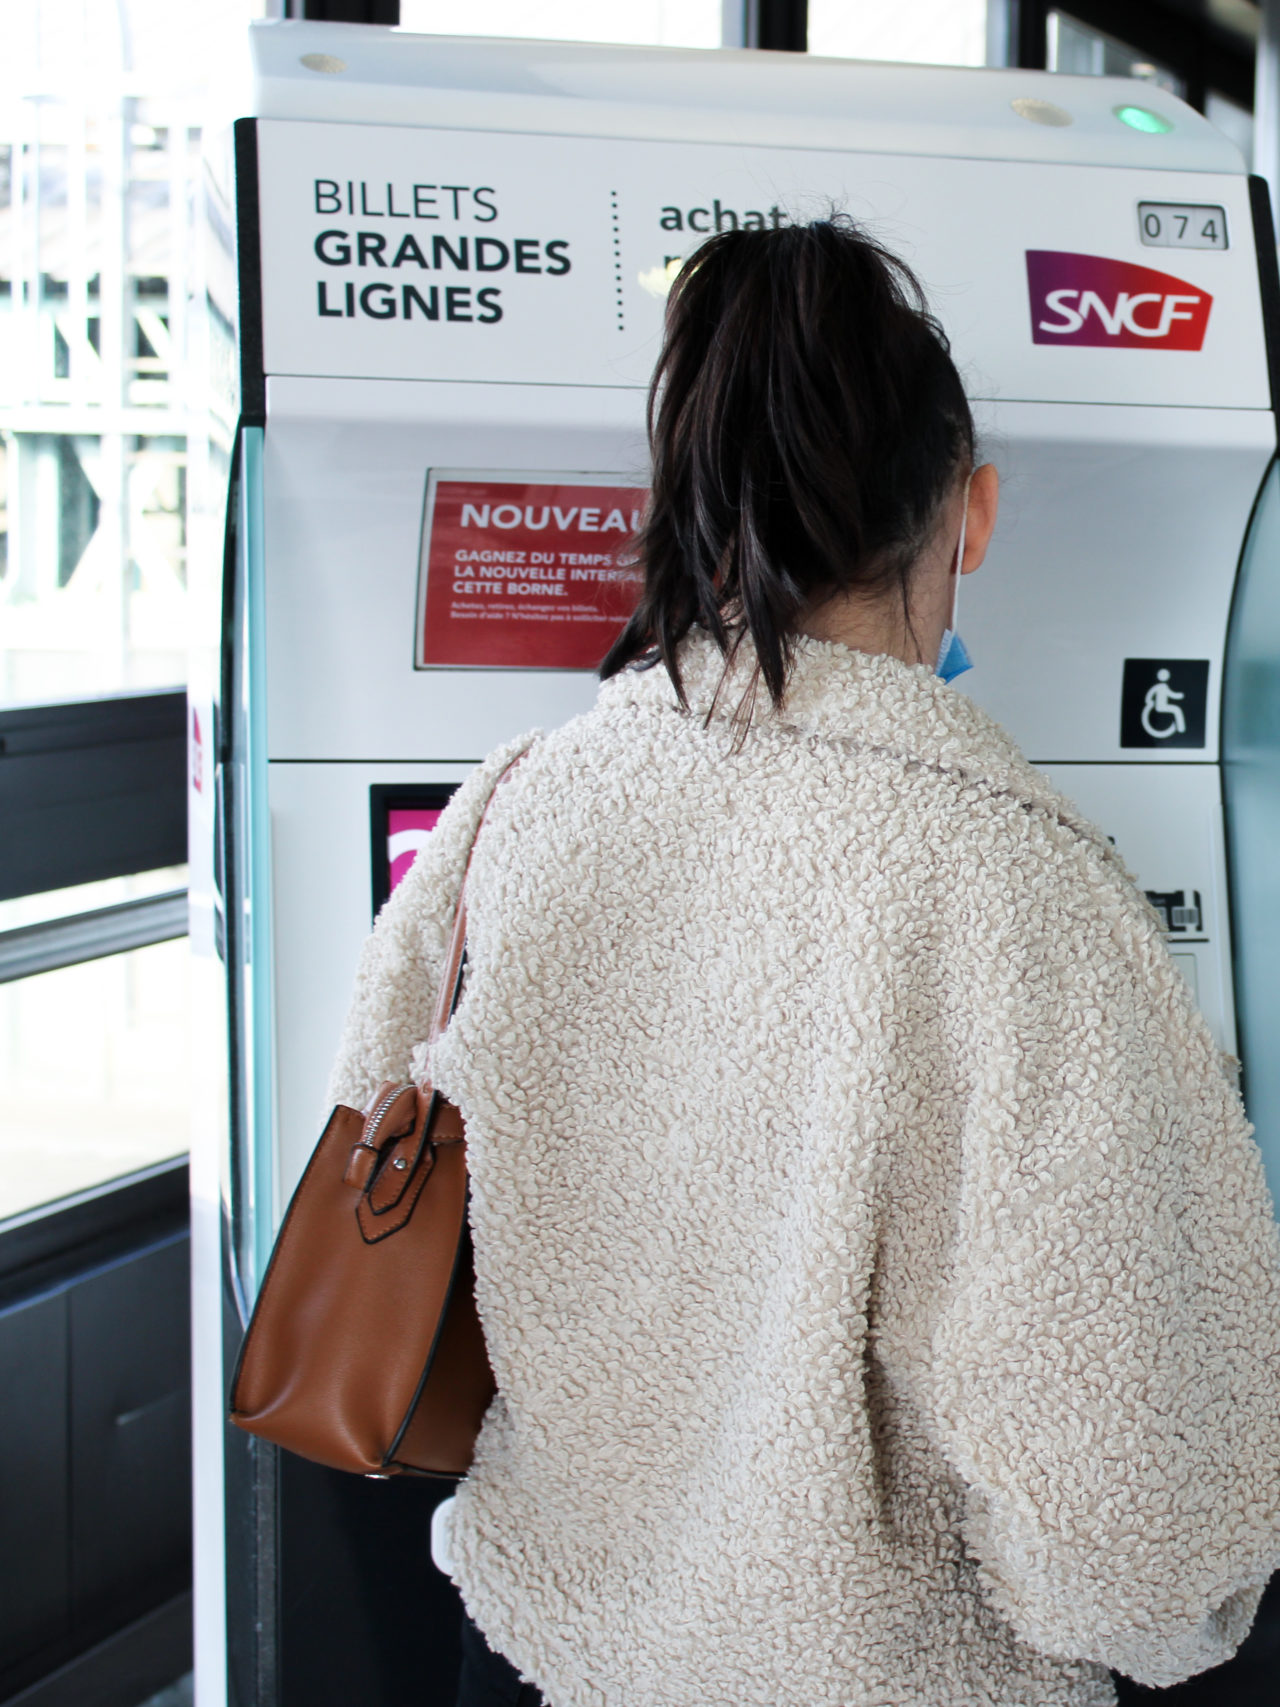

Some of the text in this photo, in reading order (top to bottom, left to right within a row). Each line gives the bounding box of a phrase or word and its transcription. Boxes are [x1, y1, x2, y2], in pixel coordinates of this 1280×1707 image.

[313, 178, 499, 222] BILLETS
[313, 229, 573, 277] GRANDES
[317, 280, 504, 324] LIGNES
[1038, 288, 1202, 339] SNCF
[453, 565, 475, 579] LA
[479, 566, 566, 581] NOUVELLE
[454, 549, 527, 565] GAGNEZ
[529, 551, 556, 565] DU
[559, 552, 612, 567] TEMPS
[452, 580, 569, 597] CETTE BORNE.
